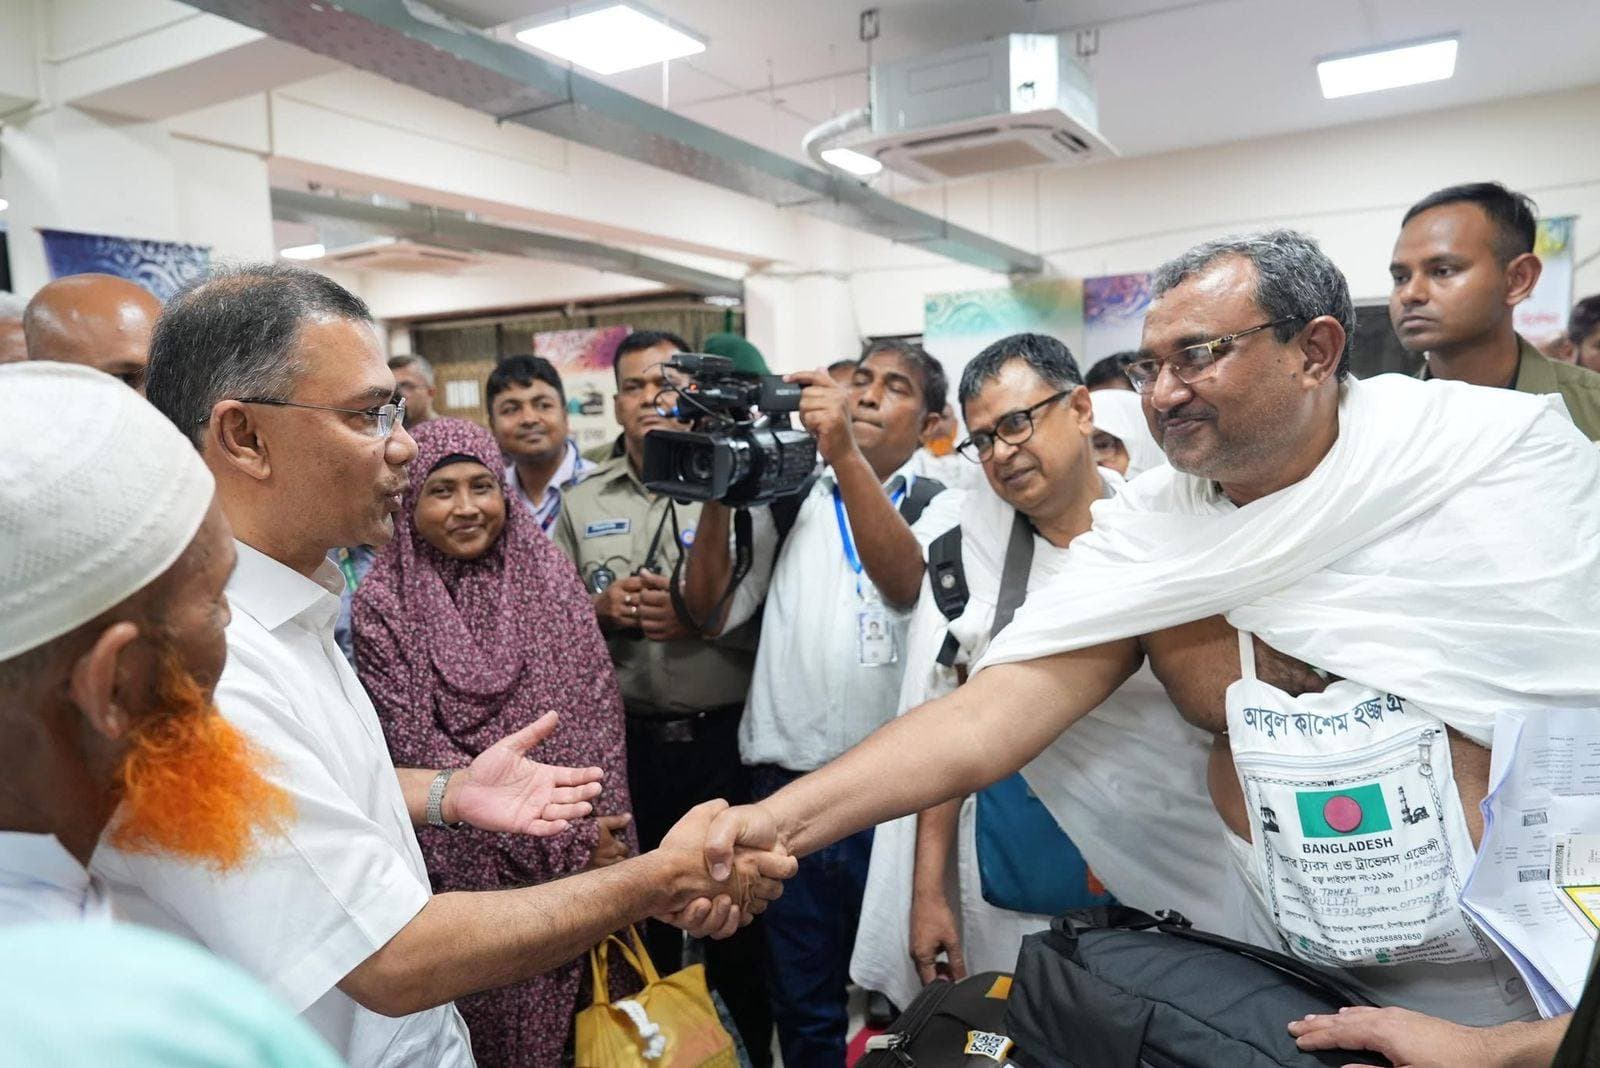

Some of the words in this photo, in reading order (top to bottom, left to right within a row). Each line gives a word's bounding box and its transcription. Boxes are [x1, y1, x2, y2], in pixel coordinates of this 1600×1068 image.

[1243, 707, 1289, 740] আবুল
[1291, 711, 1349, 736] কাশেম
[1302, 837, 1394, 854] BANGLADESH
